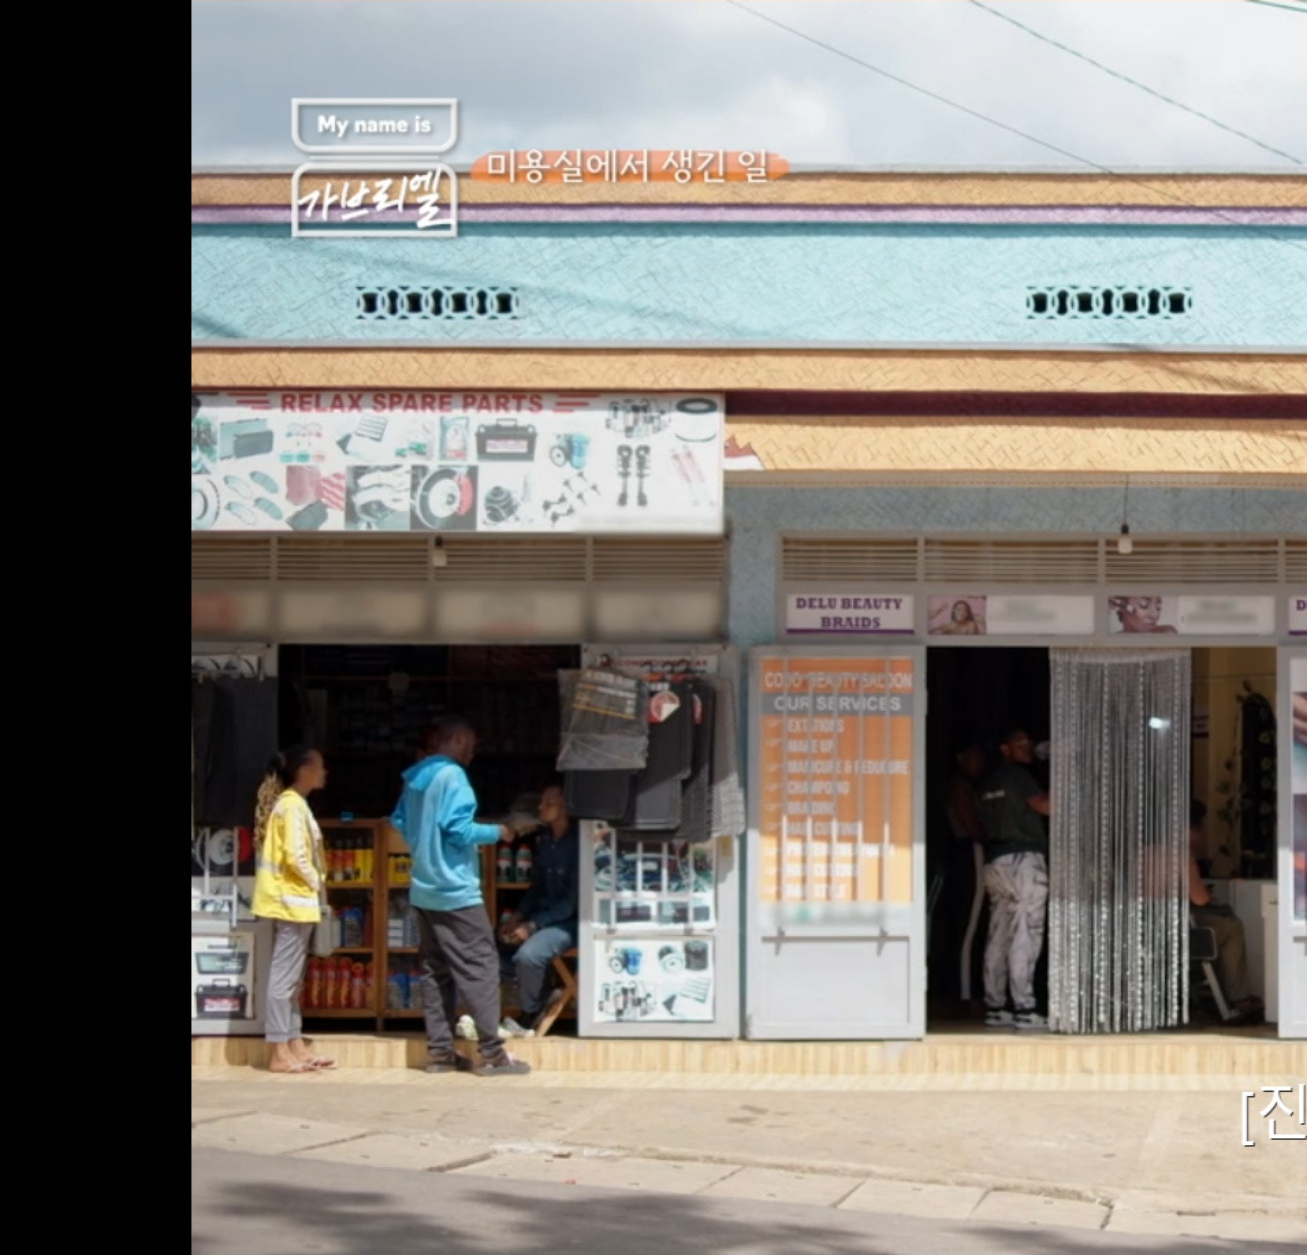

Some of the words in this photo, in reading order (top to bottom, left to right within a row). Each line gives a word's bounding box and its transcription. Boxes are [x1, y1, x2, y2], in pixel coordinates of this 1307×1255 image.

[280, 393, 364, 414] RELAX
[372, 393, 453, 414] SPARE
[463, 393, 544, 414] PARTS
[796, 598, 838, 610] DELU
[841, 598, 903, 610] BEAUTY
[821, 616, 882, 628] BRAIDS
[774, 696, 810, 711] OUR
[815, 696, 902, 711] SERVICES
